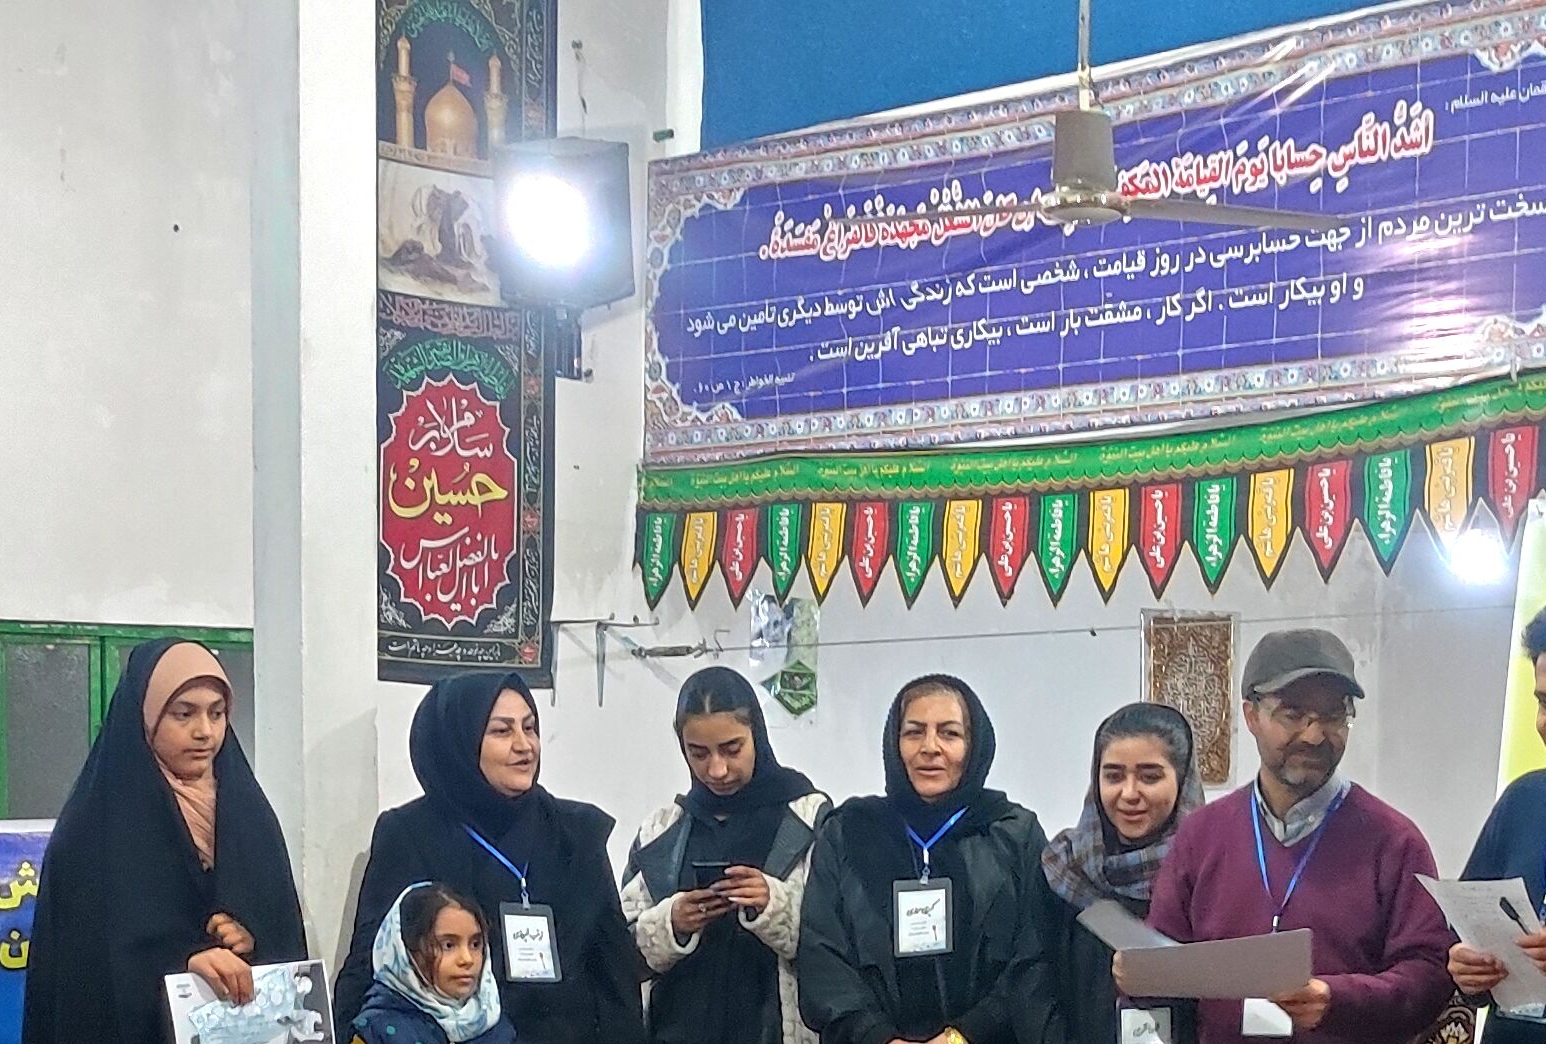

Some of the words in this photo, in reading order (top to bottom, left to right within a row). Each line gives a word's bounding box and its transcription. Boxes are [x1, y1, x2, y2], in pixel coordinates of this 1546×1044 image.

[1355, 216, 1373, 248] از
[1378, 214, 1430, 245] مردم
[1434, 204, 1486, 236] ترین
[1209, 231, 1302, 269] حسابرسی
[1304, 224, 1351, 253] جهت
[1092, 249, 1147, 281] قیامت
[1149, 249, 1181, 278] روز
[1184, 246, 1207, 272] در
[954, 273, 976, 298] که
[978, 267, 1018, 295] است
[1020, 258, 1081, 295] شخصی
[1329, 272, 1348, 304] او
[1352, 276, 1365, 300] و
[823, 293, 864, 321] توسط
[865, 287, 895, 317] اش
[899, 277, 953, 311] زندگی
[1185, 286, 1214, 322] اگر
[1278, 276, 1327, 310] بیکار
[685, 311, 715, 338] شود
[776, 297, 822, 329] دیگری
[1015, 310, 1056, 336] است
[1059, 308, 1082, 338] بار
[1155, 292, 1183, 326] کار
[715, 314, 737, 336] می
[901, 325, 948, 356] تباهی
[950, 318, 1003, 351] بیکاری
[854, 325, 902, 361] آفرین
